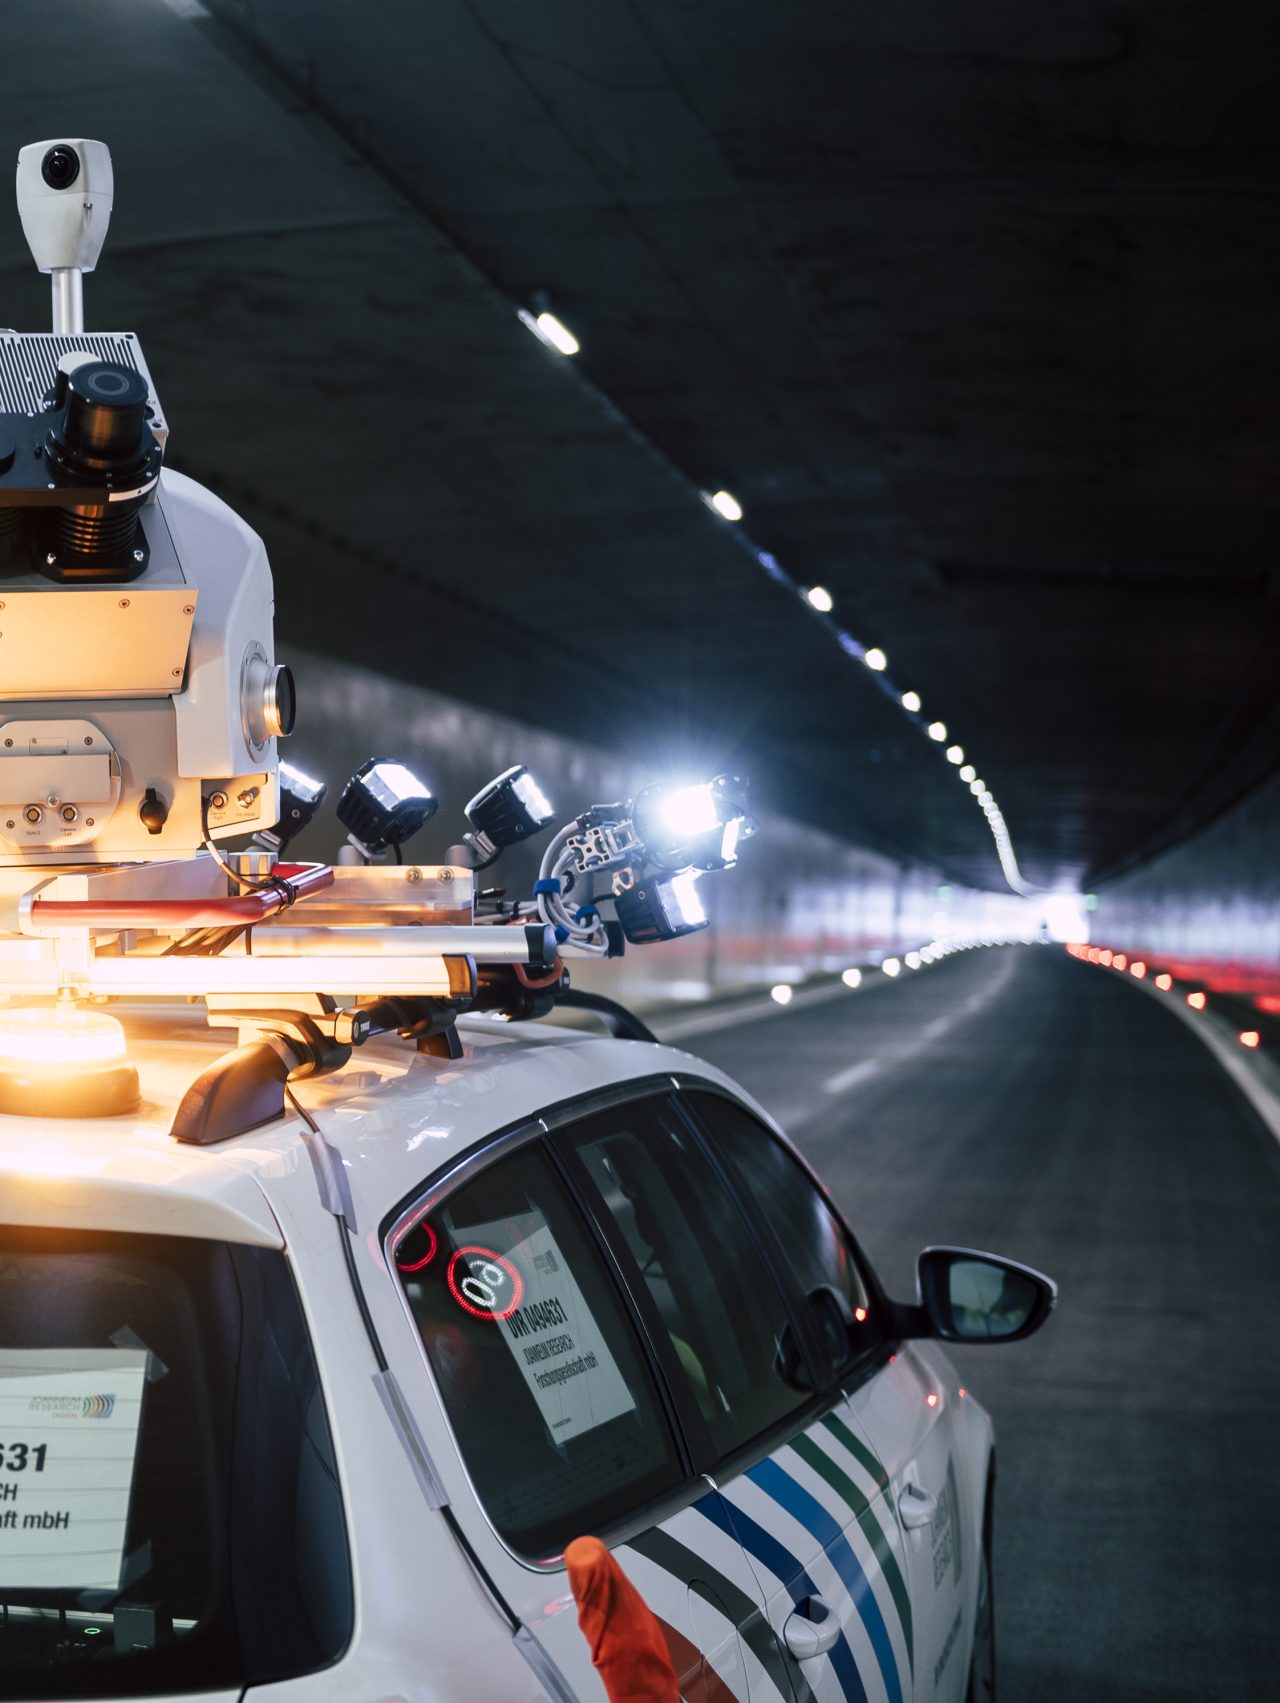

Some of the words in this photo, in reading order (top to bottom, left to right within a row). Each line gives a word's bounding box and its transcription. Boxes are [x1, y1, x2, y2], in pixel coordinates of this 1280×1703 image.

[503, 1309, 531, 1339] DVR
[523, 1296, 568, 1333] 0494631
[22, 1511, 69, 1530] mbH
